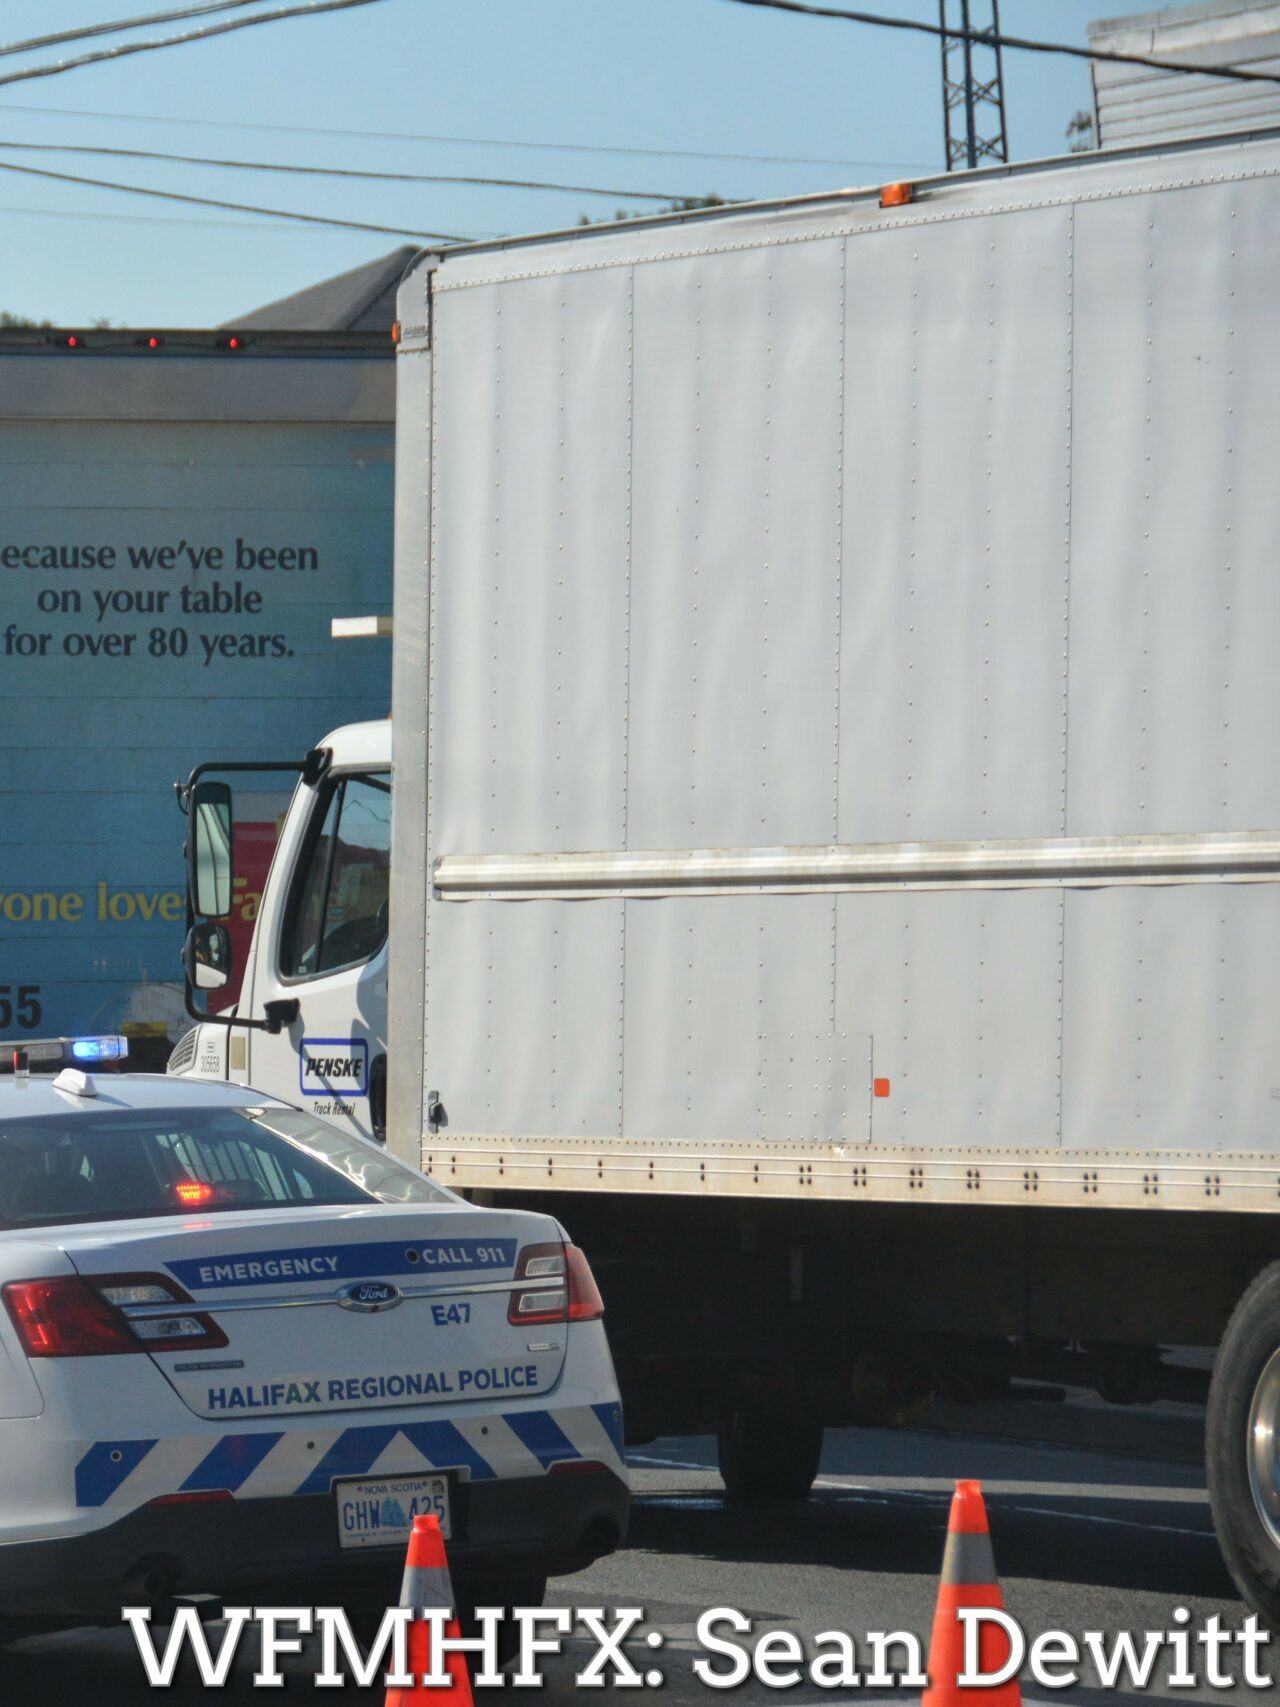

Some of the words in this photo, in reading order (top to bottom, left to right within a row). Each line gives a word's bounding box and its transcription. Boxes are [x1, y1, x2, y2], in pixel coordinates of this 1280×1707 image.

[127, 539, 224, 570] we've
[235, 538, 319, 570] been
[36, 588, 82, 613] on
[93, 588, 170, 622] your
[180, 582, 263, 614] table
[3, 623, 52, 656] for
[62, 633, 137, 657] over
[148, 626, 189, 657] 80
[199, 633, 296, 666] years.
[97, 881, 188, 922] love
[305, 1058, 363, 1078] PENSKE
[313, 1101, 332, 1115] Truck
[333, 1102, 356, 1116] Rental
[199, 1255, 339, 1284] EMERGENCY
[422, 1247, 474, 1265] CALL
[476, 1246, 506, 1264] 911
[359, 1285, 388, 1300] Ford
[430, 1303, 471, 1327] E47
[207, 1380, 322, 1410] HALIFAX
[328, 1371, 453, 1401] REGIONAL
[458, 1365, 539, 1391] POLICE
[365, 1484, 388, 1496] NOVA
[391, 1482, 423, 1493] SCOTIA
[343, 1499, 380, 1531] GHW
